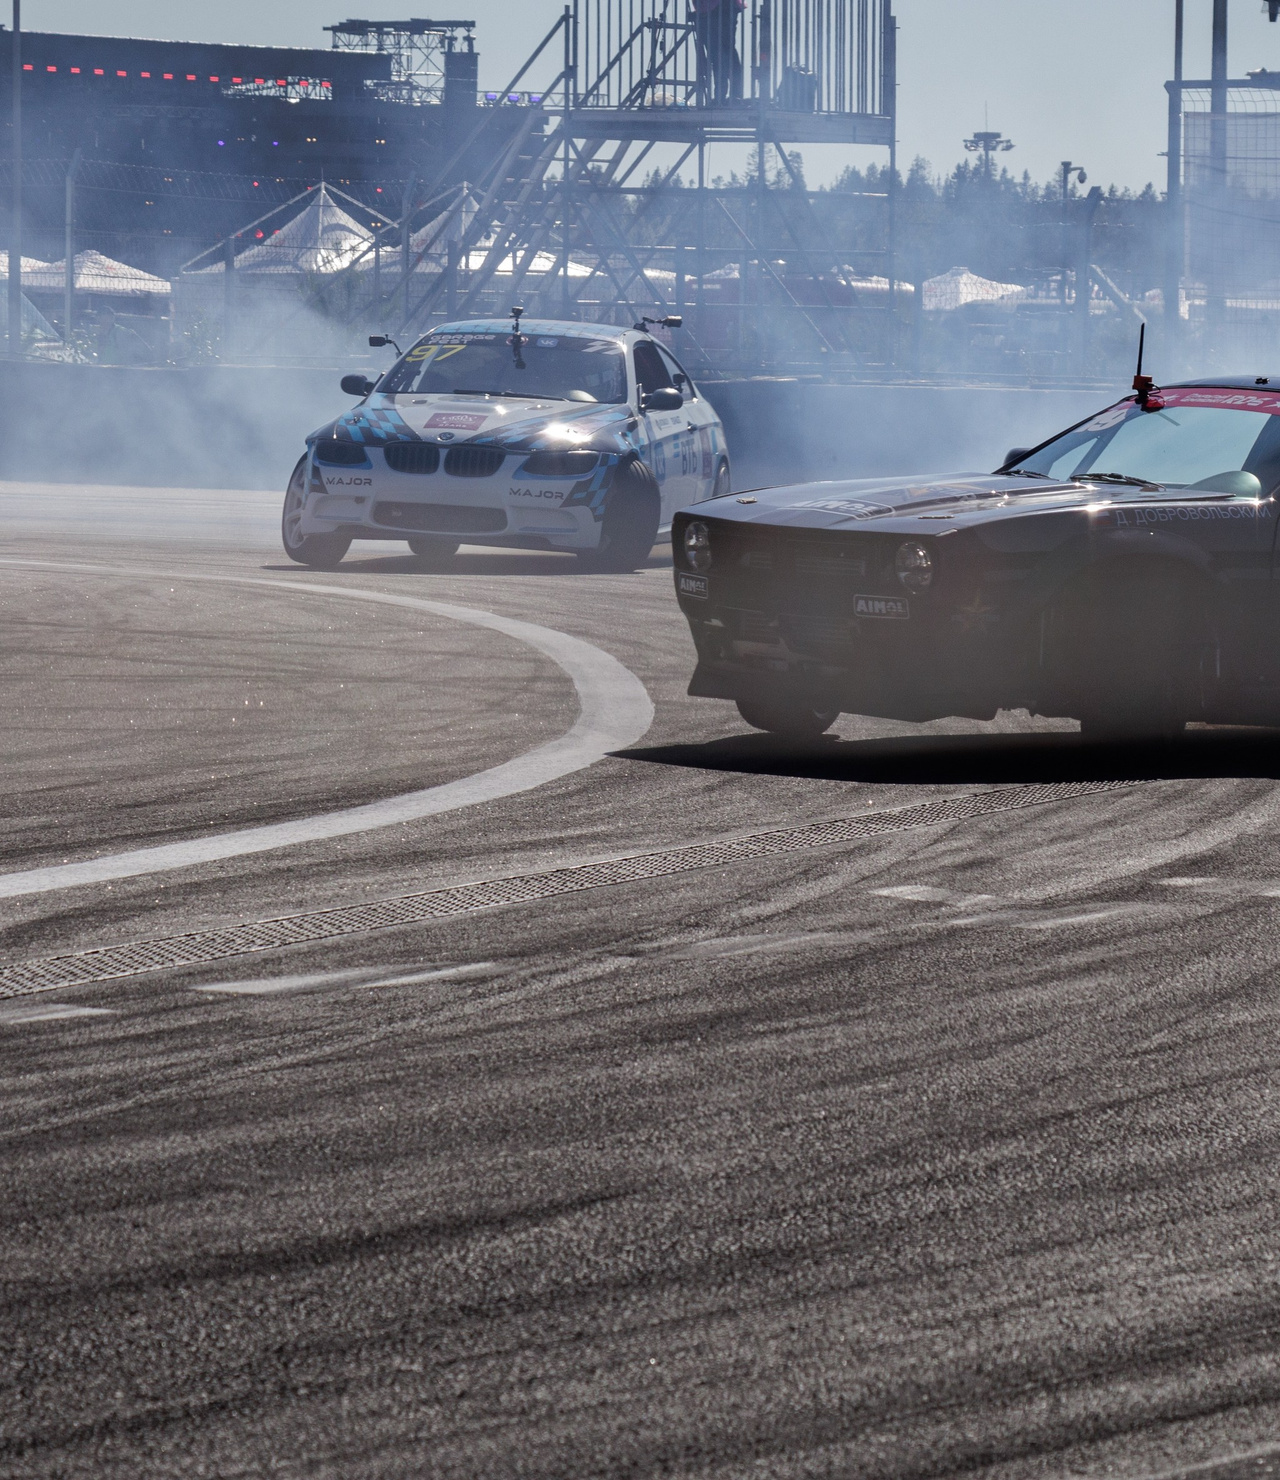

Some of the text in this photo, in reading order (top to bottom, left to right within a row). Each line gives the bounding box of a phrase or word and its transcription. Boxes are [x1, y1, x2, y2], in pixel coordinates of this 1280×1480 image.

[404, 344, 467, 362] 97
[325, 476, 373, 487] MAJOR
[509, 487, 565, 500] MAJOR
[857, 599, 906, 614] AIMOL
